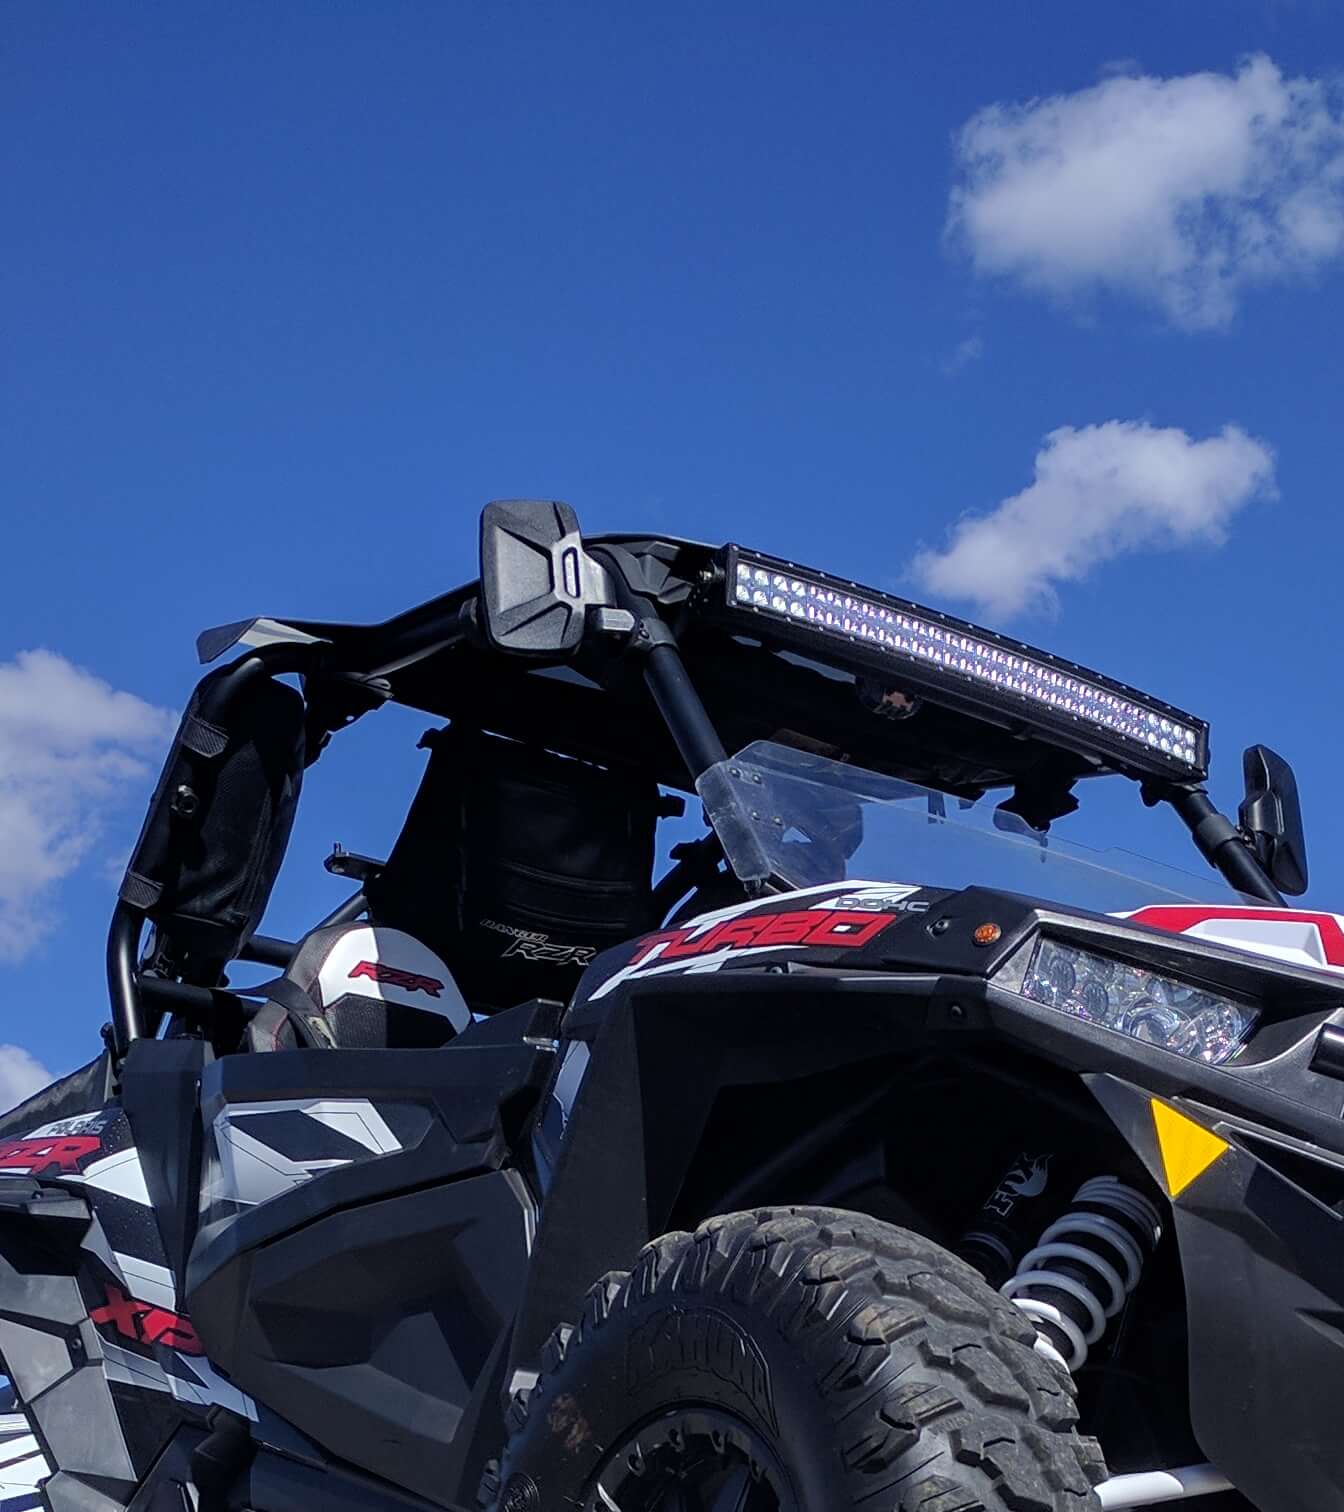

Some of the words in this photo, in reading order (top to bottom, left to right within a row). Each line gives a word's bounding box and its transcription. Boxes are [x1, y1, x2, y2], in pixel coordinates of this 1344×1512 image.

[836, 896, 931, 913] DOHC
[500, 938, 598, 967] RZR
[628, 910, 897, 965] TURBO
[348, 960, 445, 998] RZR
